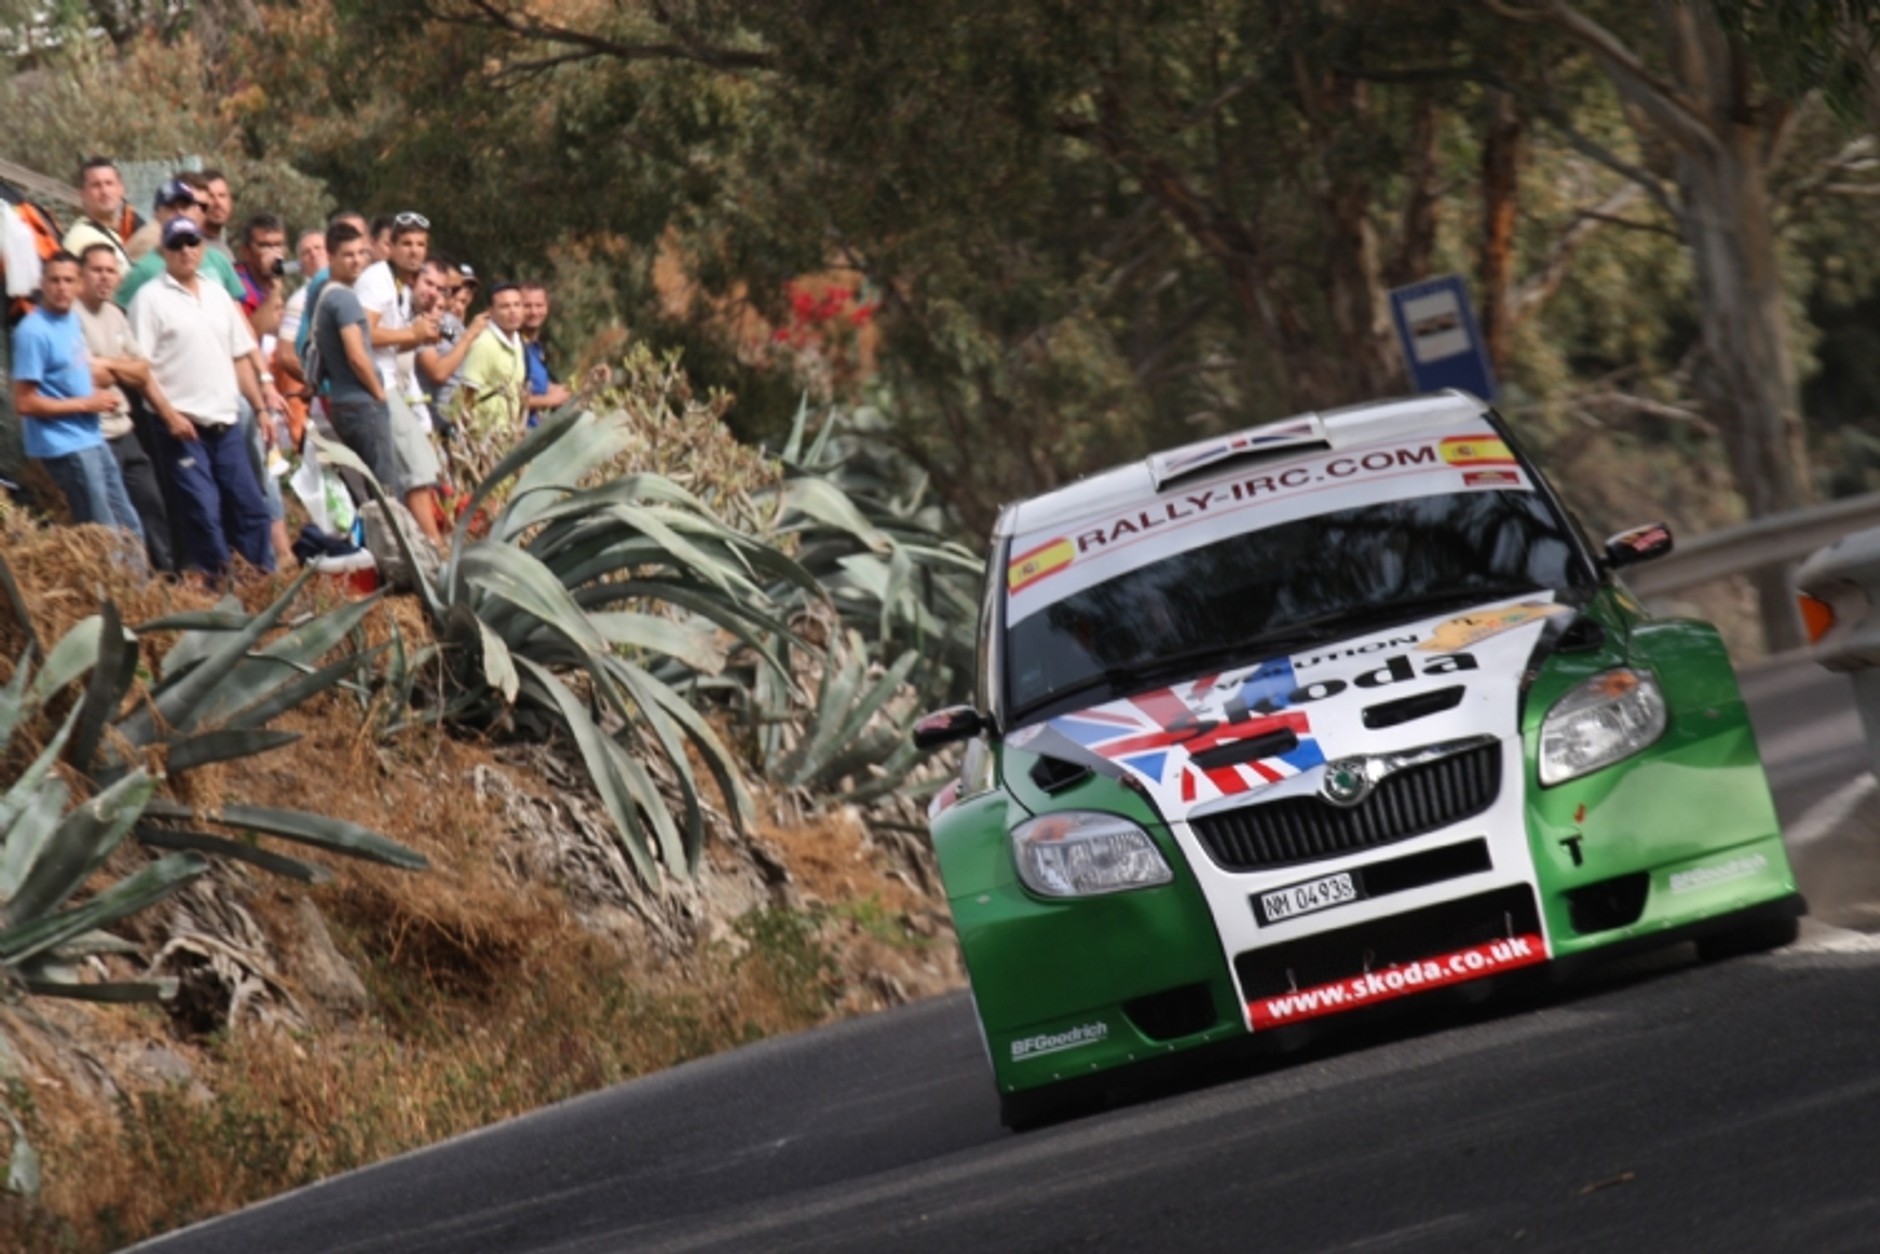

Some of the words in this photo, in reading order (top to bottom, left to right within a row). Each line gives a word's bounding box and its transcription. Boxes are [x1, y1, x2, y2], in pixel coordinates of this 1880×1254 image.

[1076, 445, 1436, 552] RALLY-IRC.COM
[1265, 893, 1291, 918] NM
[1267, 936, 1533, 1018] www.skoda.co.uk
[1010, 1021, 1108, 1056] BFGoodrich
